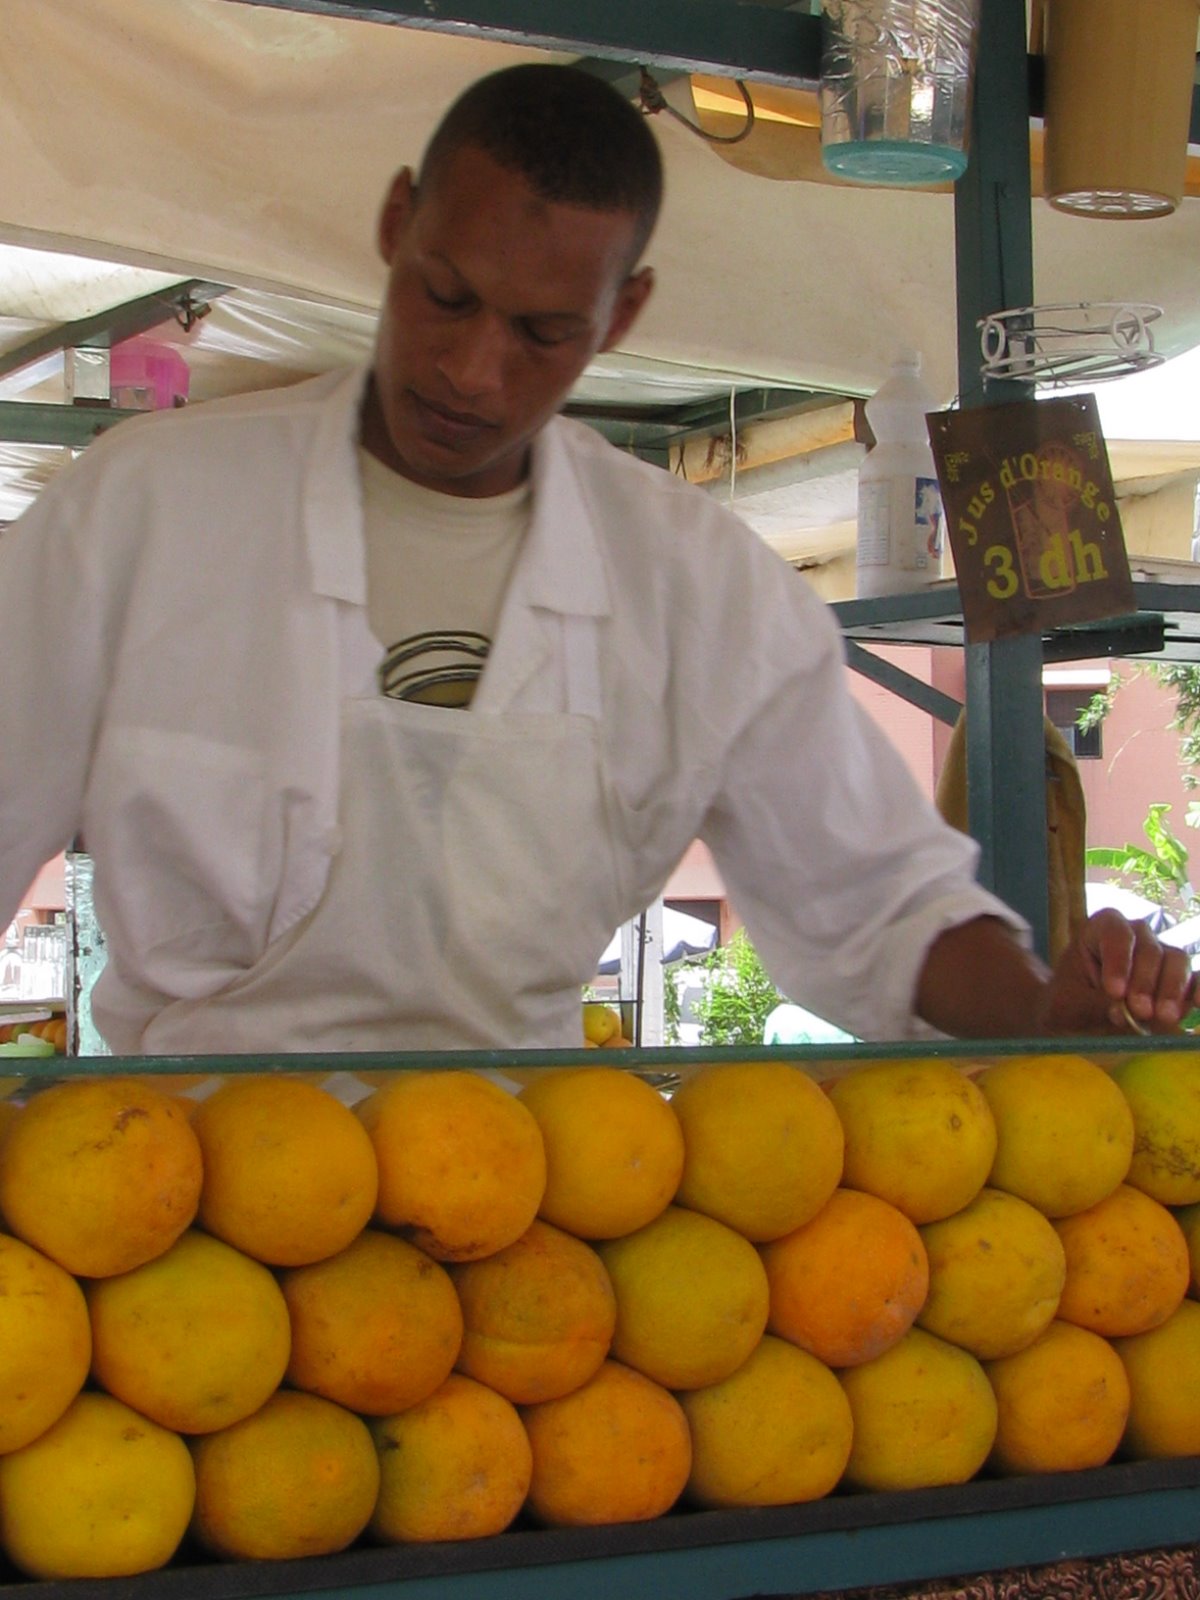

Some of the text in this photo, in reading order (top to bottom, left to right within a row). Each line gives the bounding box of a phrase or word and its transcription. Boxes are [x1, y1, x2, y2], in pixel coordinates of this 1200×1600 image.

[959, 453, 1110, 546] Jus d'Orange
[984, 529, 1108, 599] 3 dh
